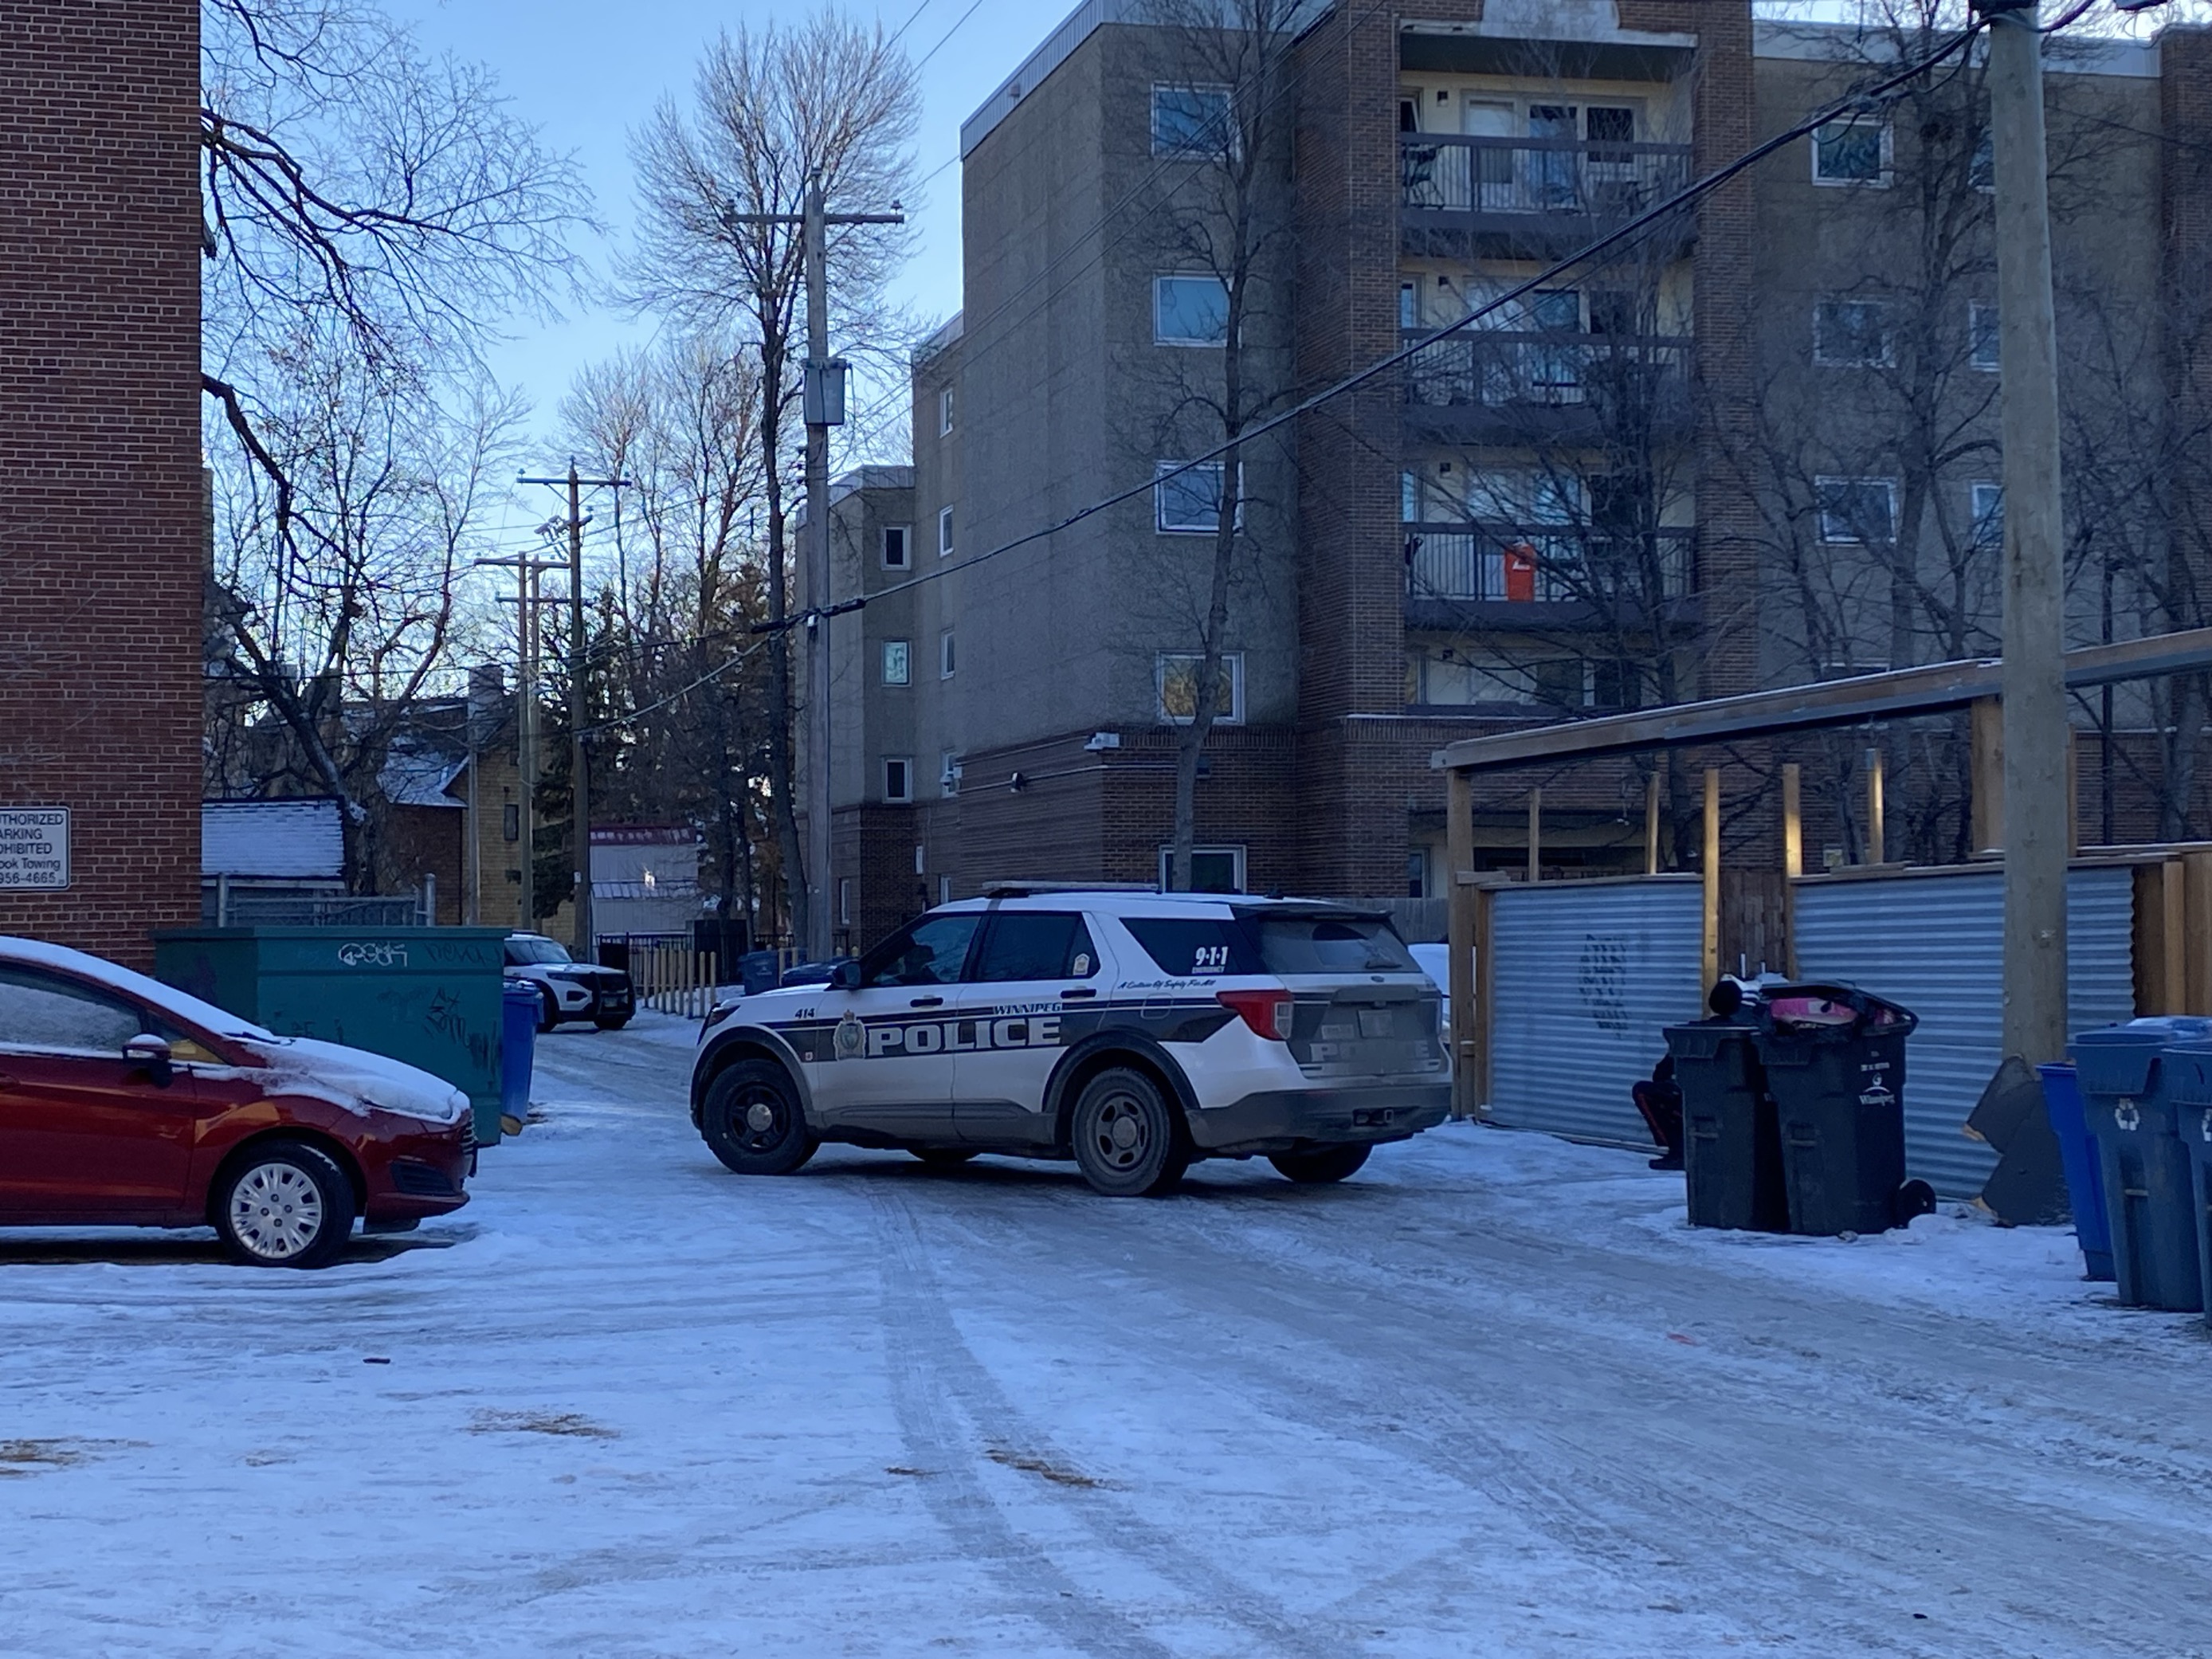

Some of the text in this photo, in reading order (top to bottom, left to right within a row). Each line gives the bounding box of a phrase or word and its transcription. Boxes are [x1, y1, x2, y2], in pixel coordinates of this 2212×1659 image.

[0, 814, 64, 825] THORIZED
[22, 857, 61, 872] Towing
[794, 1008, 815, 1019] 414
[994, 1002, 1061, 1015] WINNIPEG
[869, 1016, 1061, 1056] POLICE
